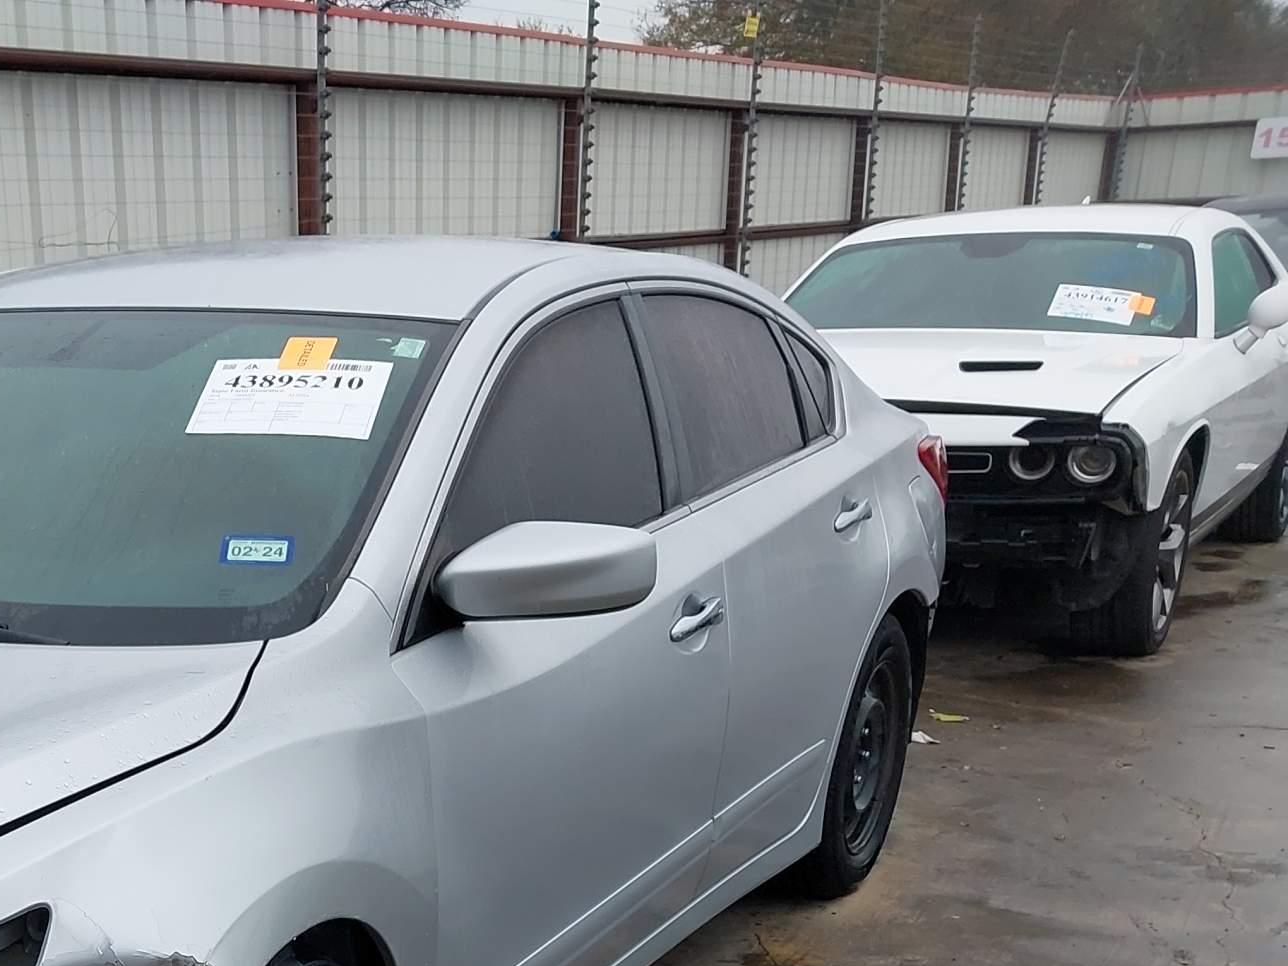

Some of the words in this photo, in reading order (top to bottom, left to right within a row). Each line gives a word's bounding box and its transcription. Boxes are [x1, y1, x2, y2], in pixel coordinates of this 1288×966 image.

[224, 374, 364, 390] 43895210
[231, 545, 253, 557] 02
[262, 546, 284, 558] 24
